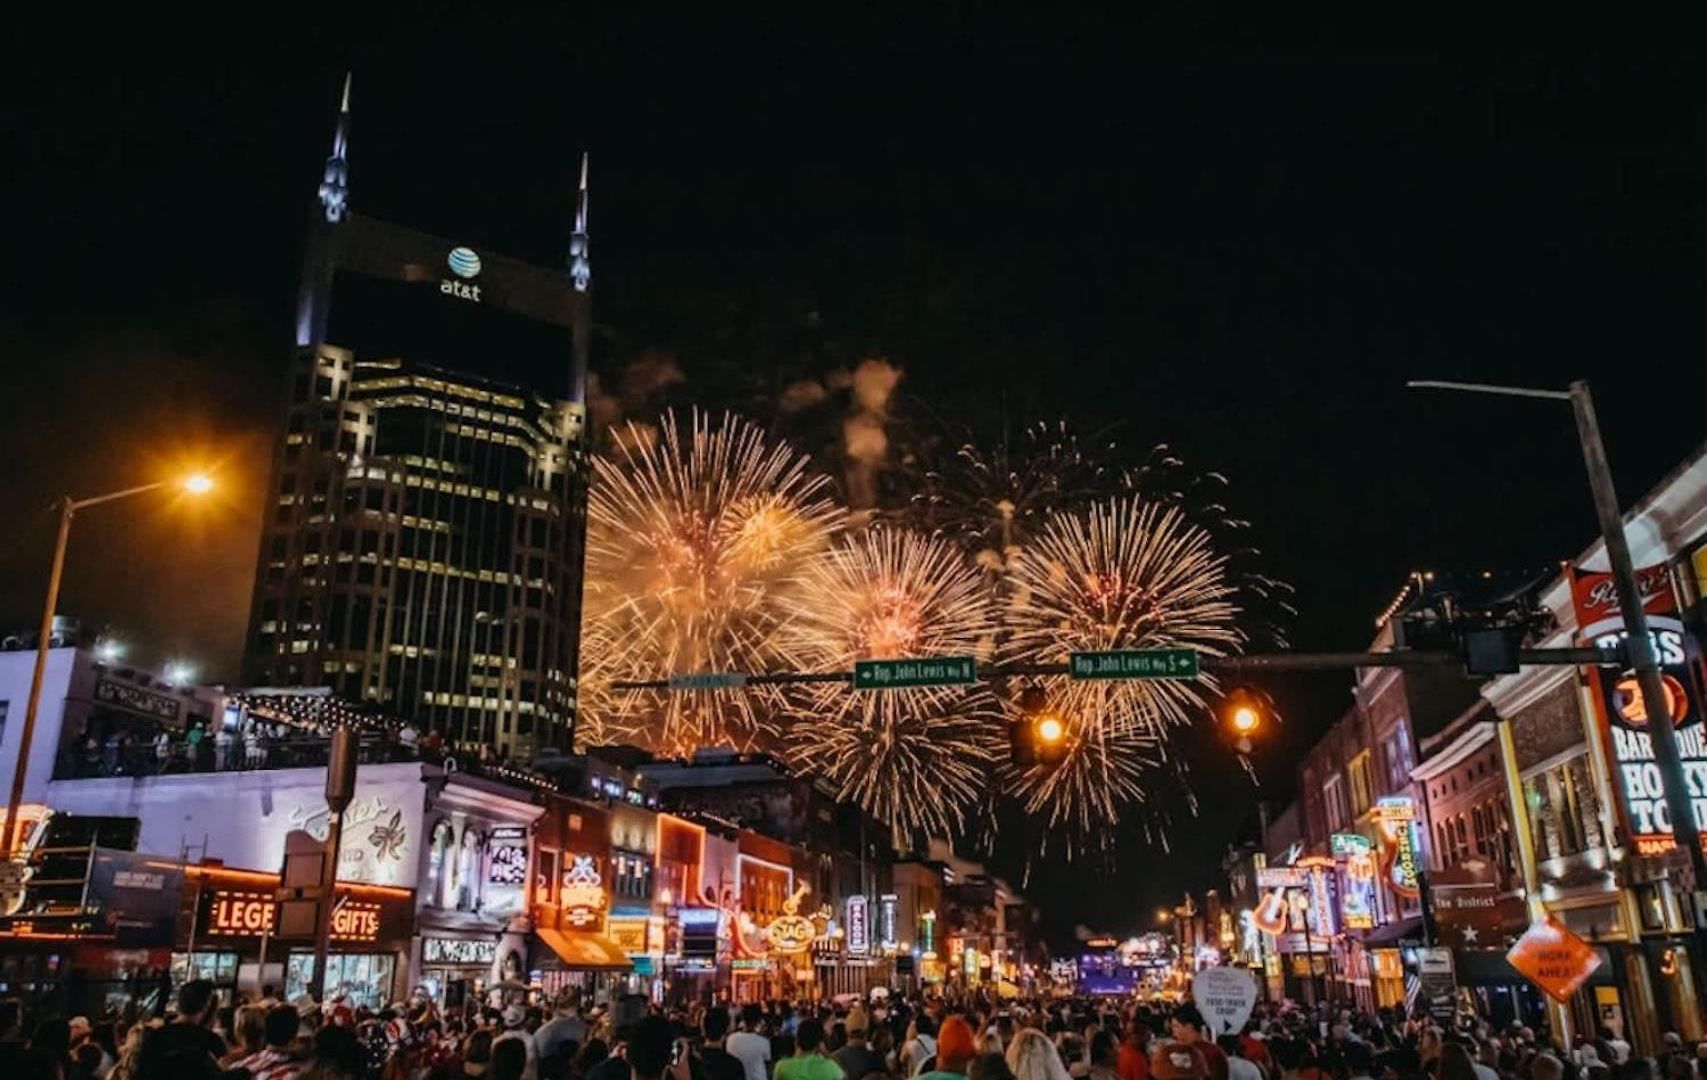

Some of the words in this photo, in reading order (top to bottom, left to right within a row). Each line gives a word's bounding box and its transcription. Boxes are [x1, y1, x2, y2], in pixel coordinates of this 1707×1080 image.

[440, 280, 481, 302] at&t
[1457, 897, 1496, 908] District
[217, 901, 275, 930] LEGE
[334, 909, 377, 934] GIFTS
